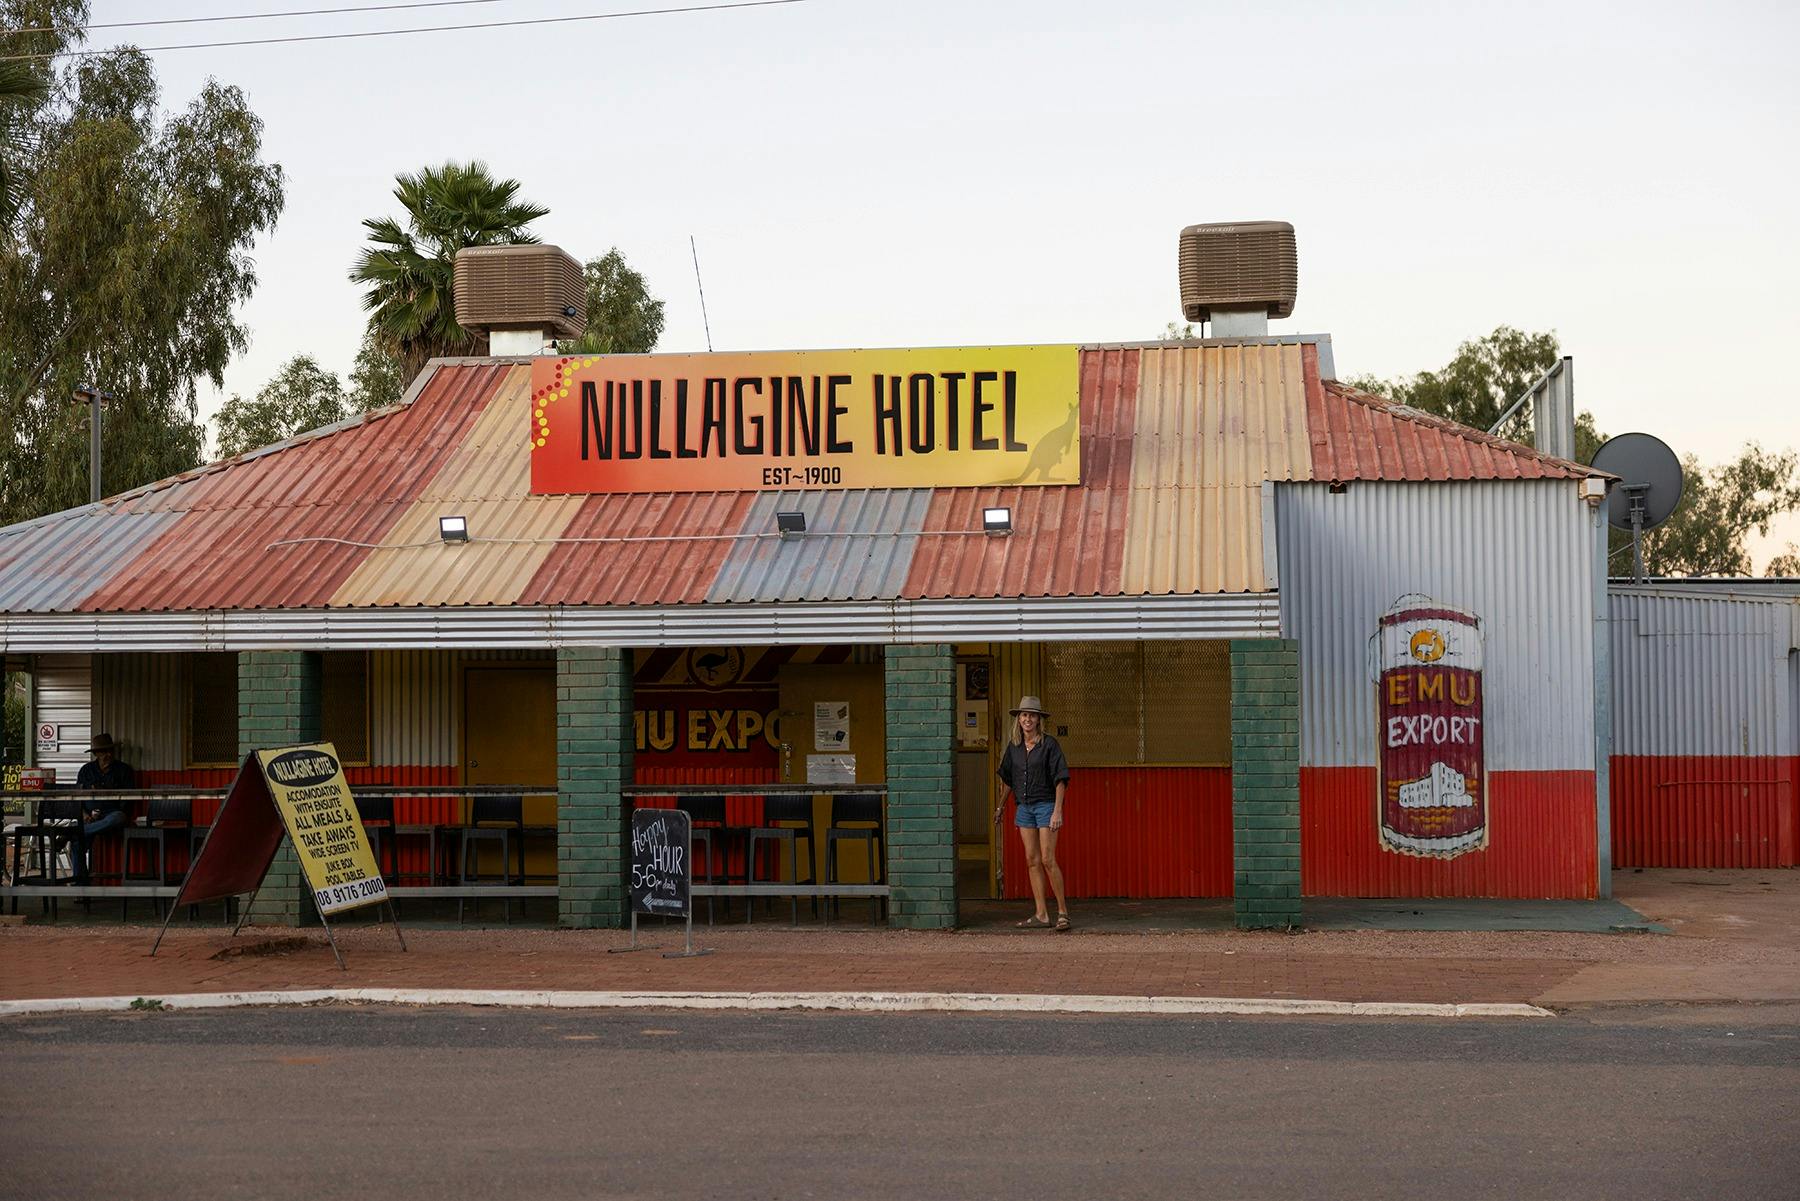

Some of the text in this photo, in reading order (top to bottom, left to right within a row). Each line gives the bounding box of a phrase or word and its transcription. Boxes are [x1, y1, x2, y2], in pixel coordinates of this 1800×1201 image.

[580, 370, 1028, 461] NULLAGINE HOTEL
[763, 466, 841, 486] EST~1900
[1387, 672, 1477, 706] EMU
[1387, 714, 1479, 748] EXPORT
[272, 756, 335, 781] NULLAGINE HOTEL
[286, 785, 342, 803] ACCOMODATION
[294, 798, 342, 814] WITH ENSUITE
[295, 808, 353, 831] ALL MEALS &
[300, 825, 356, 848] TAKE AWAYS
[632, 817, 668, 856] Happy
[308, 841, 360, 859] WIDE SCREEN TV
[653, 845, 683, 876] HOUR
[325, 858, 355, 873] JUKE BOX
[325, 868, 366, 886] POOL TABLES
[317, 878, 384, 906] 08 9176 2000
